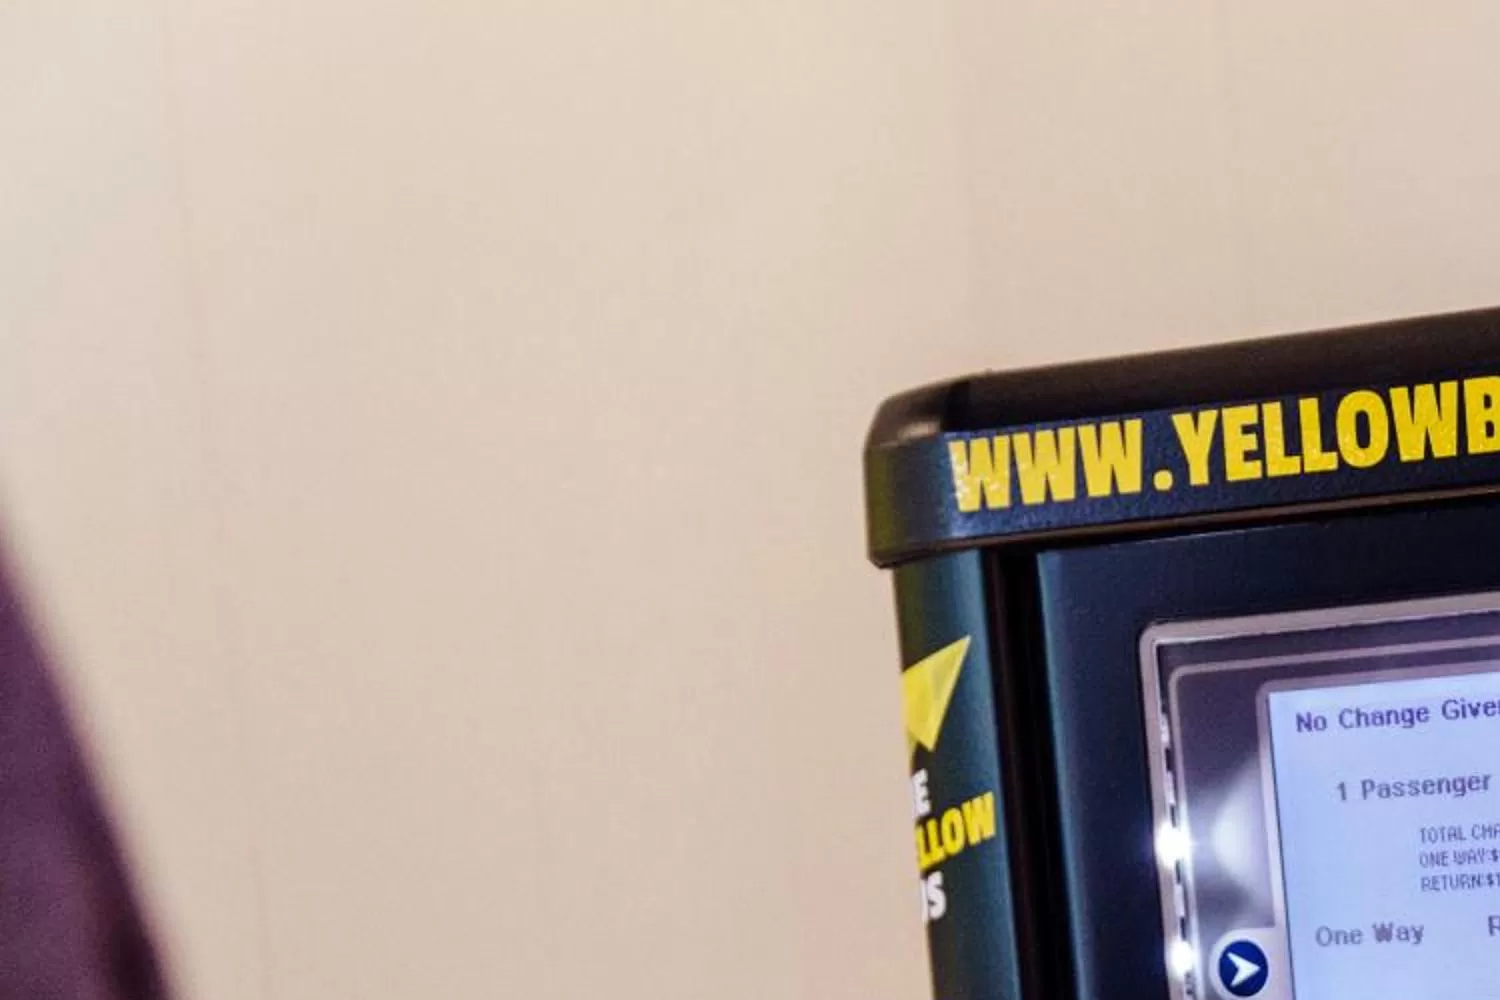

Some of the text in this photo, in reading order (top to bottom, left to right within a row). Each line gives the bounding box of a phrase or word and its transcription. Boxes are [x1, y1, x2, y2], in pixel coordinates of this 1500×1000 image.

[1296, 711, 1327, 732] No
[1339, 702, 1430, 731] Change
[1336, 782, 1348, 801] 1
[1361, 772, 1491, 800] Passenger
[1420, 825, 1467, 844] TOTAL
[1420, 851, 1449, 868] ONE
[1316, 921, 1424, 946] One Way
